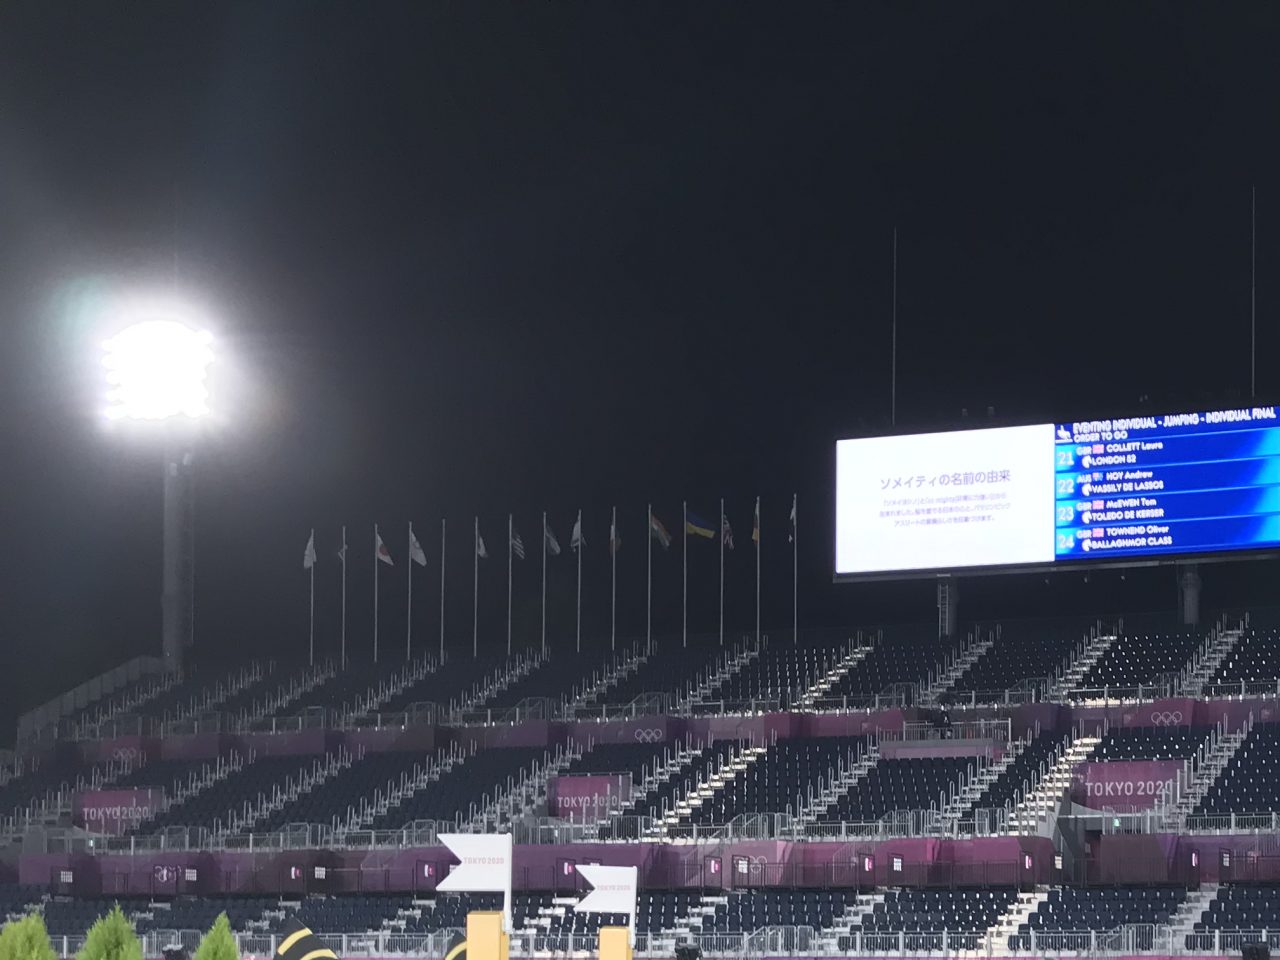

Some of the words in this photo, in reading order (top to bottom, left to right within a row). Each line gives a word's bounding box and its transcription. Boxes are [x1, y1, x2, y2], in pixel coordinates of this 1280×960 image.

[1073, 420, 1111, 434] EVENTING
[1113, 417, 1157, 430] INDIVIDUAL
[1163, 413, 1199, 427] JUMPING
[1206, 410, 1251, 424] INDIVIDUAL
[1252, 407, 1276, 420] FINAL
[1074, 433, 1100, 442] ORDER
[1101, 432, 1112, 441] TO
[1114, 431, 1128, 440] GO
[1106, 442, 1140, 453] COLLETT
[1141, 441, 1163, 450] Laura
[1057, 452, 1074, 466] 21
[1091, 456, 1126, 466] LONDON
[880, 469, 1012, 490] ソメイティの名前の由来
[1106, 472, 1123, 481] HOY
[1125, 470, 1153, 479] Andrew
[1057, 479, 1074, 494] 22
[1091, 484, 1122, 495] VASSILY
[1123, 482, 1133, 491] DE
[1134, 480, 1164, 490] LASSOS
[1141, 498, 1156, 506] Tom
[1057, 506, 1074, 521] 23
[1091, 511, 1123, 522] TOLEDO
[1125, 510, 1135, 519] DE
[1106, 526, 1145, 536] TOWNEND
[1146, 525, 1169, 534] Oliver
[1057, 534, 1074, 548] 24
[1148, 536, 1172, 546] CLASS
[1085, 781, 1134, 796] TOKYO
[557, 796, 590, 808] TOKYO
[82, 806, 120, 821] TOKYO
[464, 857, 487, 865] TOKYO
[488, 857, 505, 865] 2020
